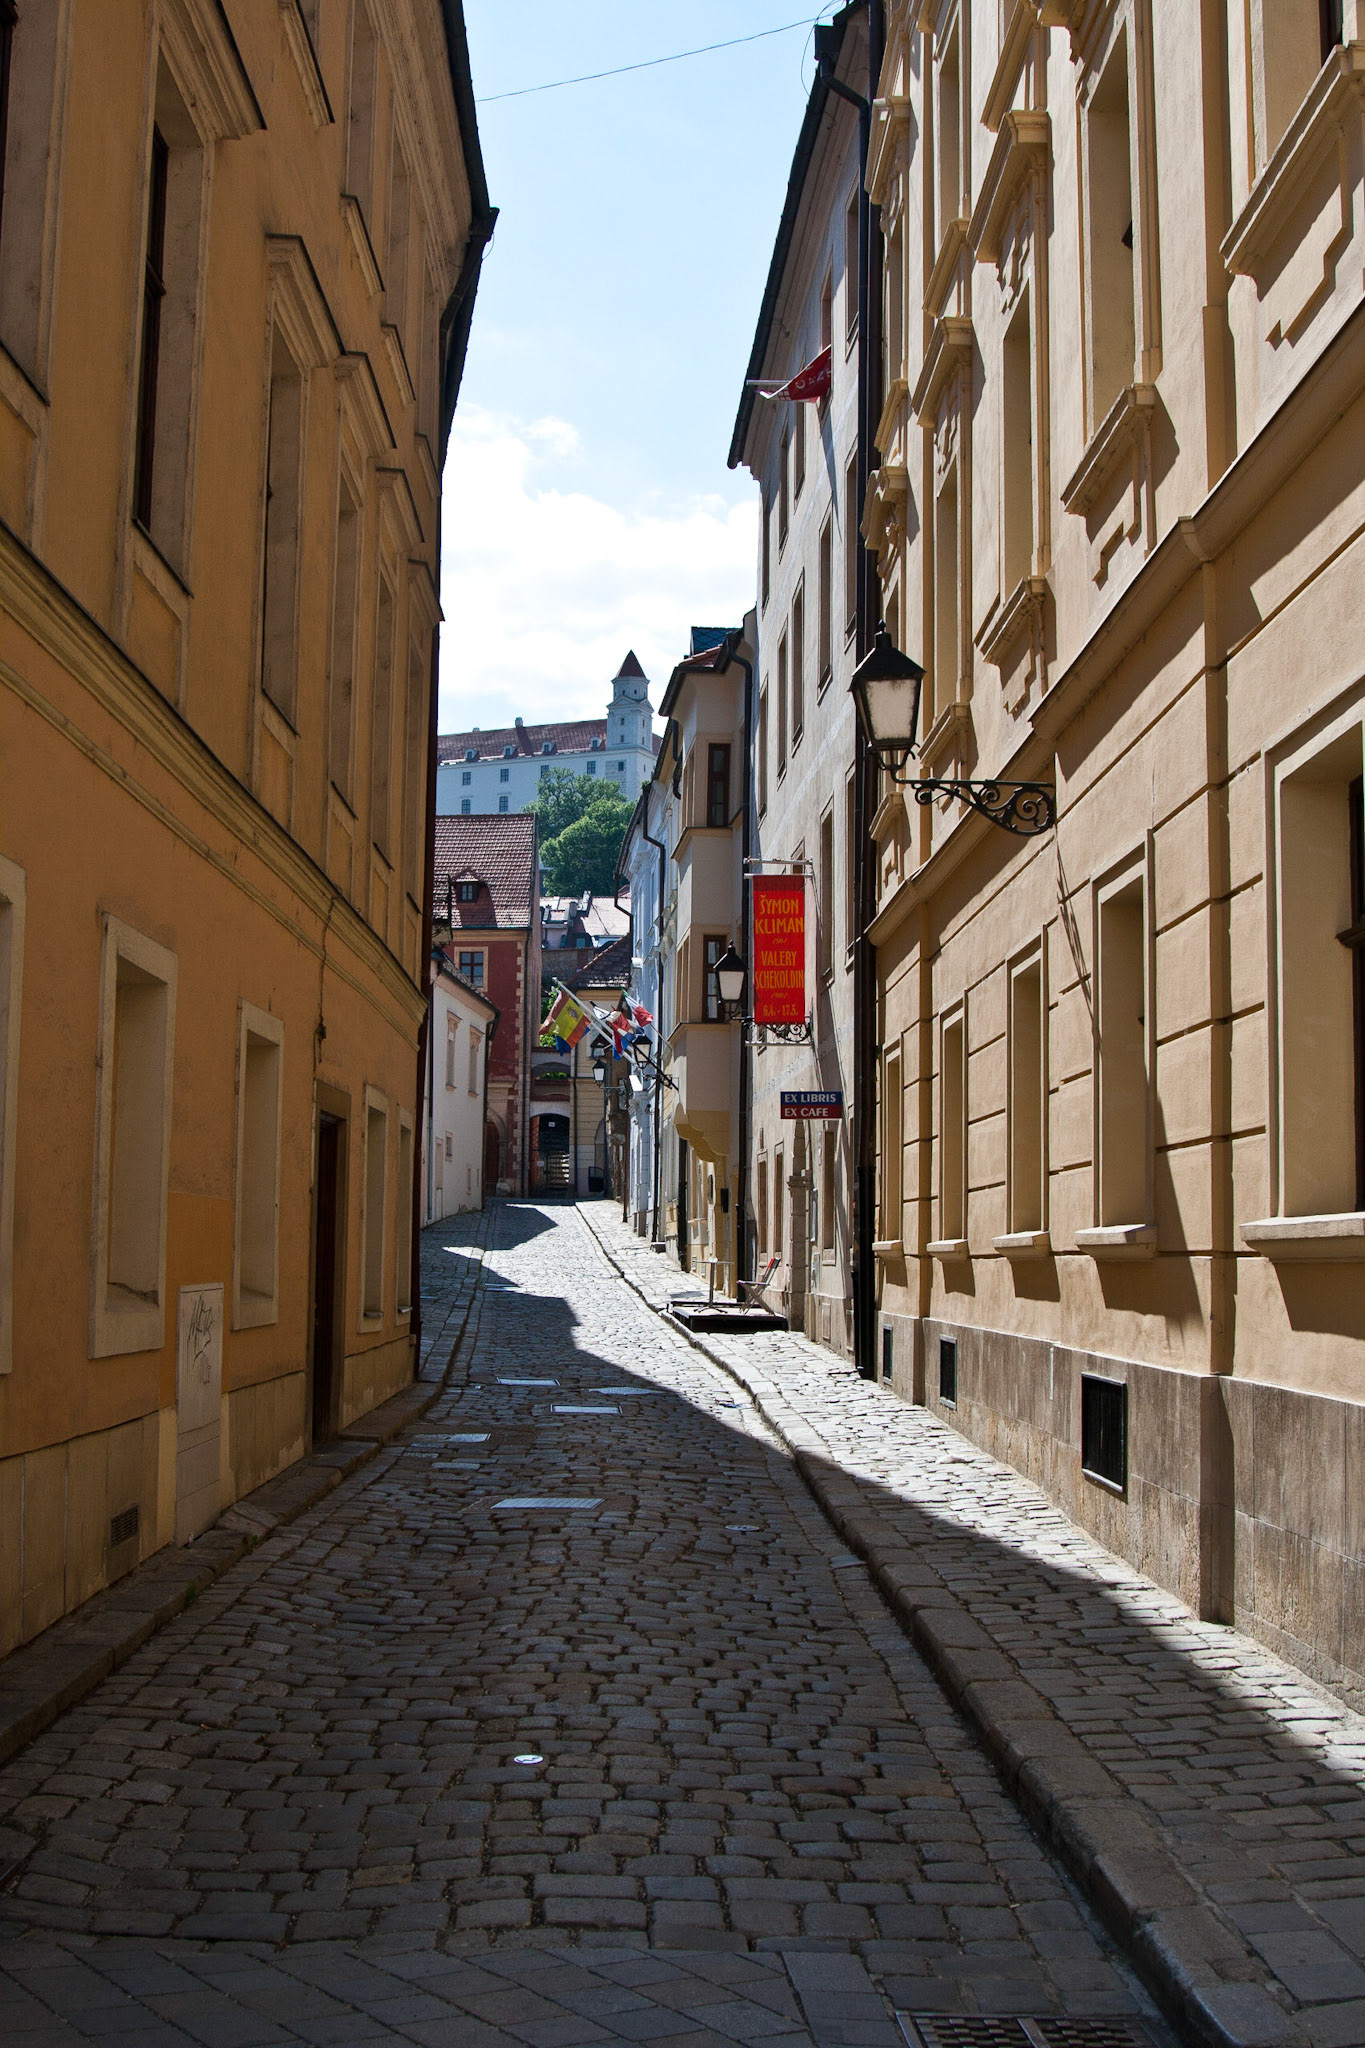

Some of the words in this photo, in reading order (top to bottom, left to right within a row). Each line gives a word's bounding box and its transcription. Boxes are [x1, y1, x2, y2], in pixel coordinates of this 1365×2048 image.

[759, 894, 799, 915] ŠYMON
[754, 917, 804, 934] KLIMAN
[761, 951, 797, 967] VALERY
[755, 970, 804, 989] SCHEKOLDIN
[784, 1094, 797, 1103] EX
[801, 1094, 836, 1103] LIBRIS
[784, 1108, 797, 1117] EX
[801, 1108, 829, 1117] CAFE
